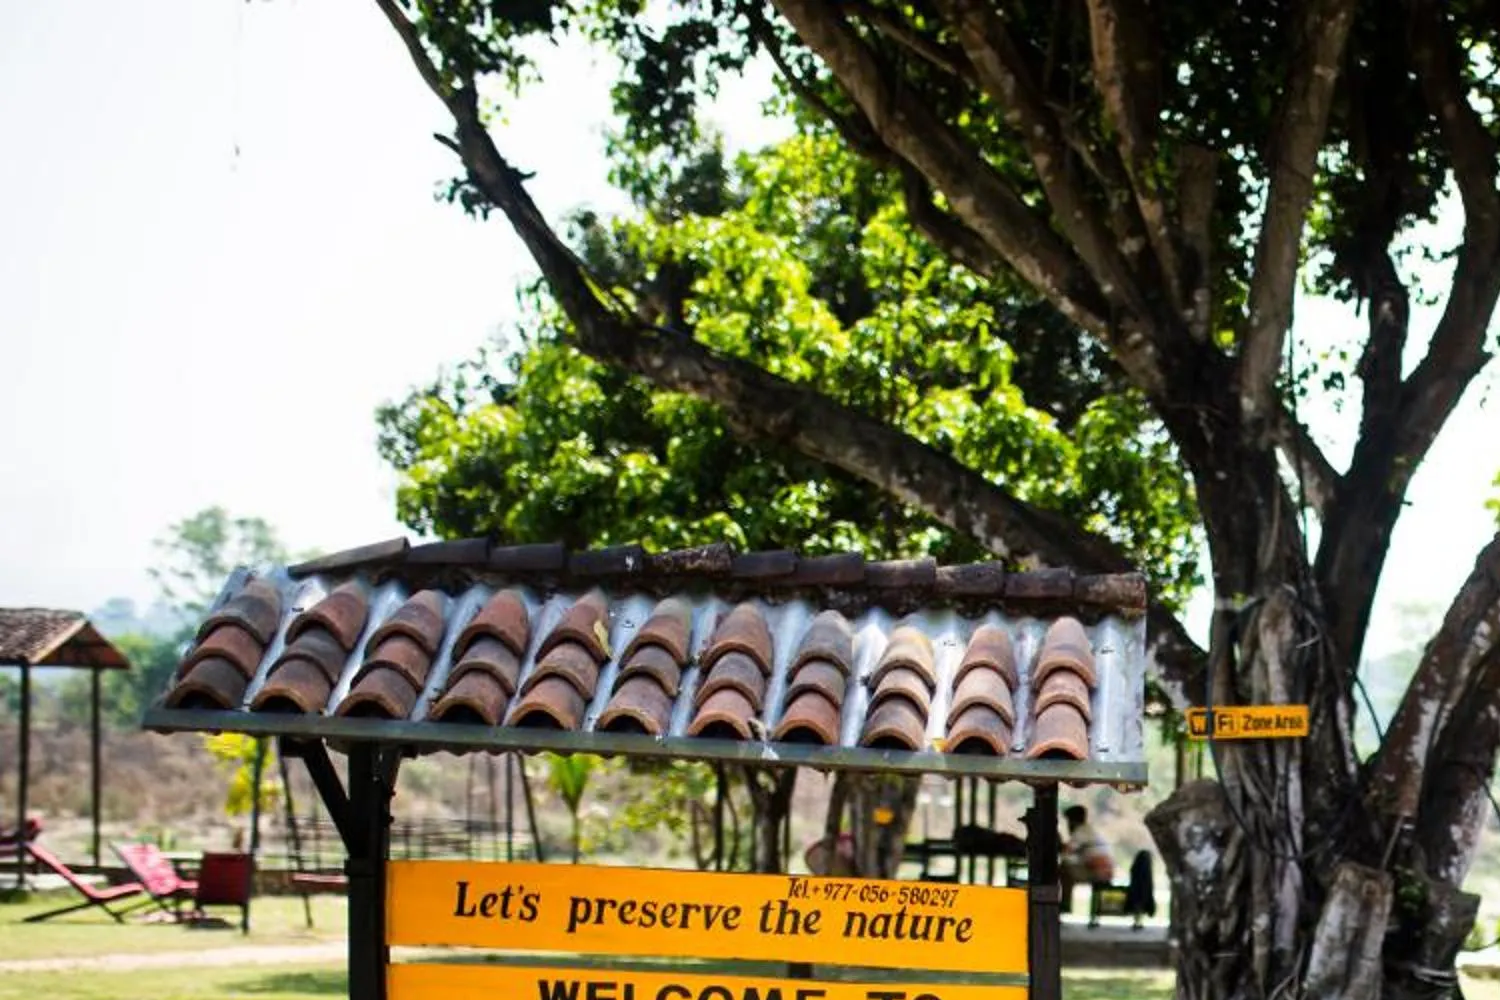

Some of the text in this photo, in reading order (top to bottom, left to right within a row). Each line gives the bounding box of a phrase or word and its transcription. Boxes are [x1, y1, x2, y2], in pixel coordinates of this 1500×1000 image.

[1242, 713, 1273, 731] Zone
[1274, 714, 1303, 730] Area
[454, 881, 973, 943] Let's preserve the nature
